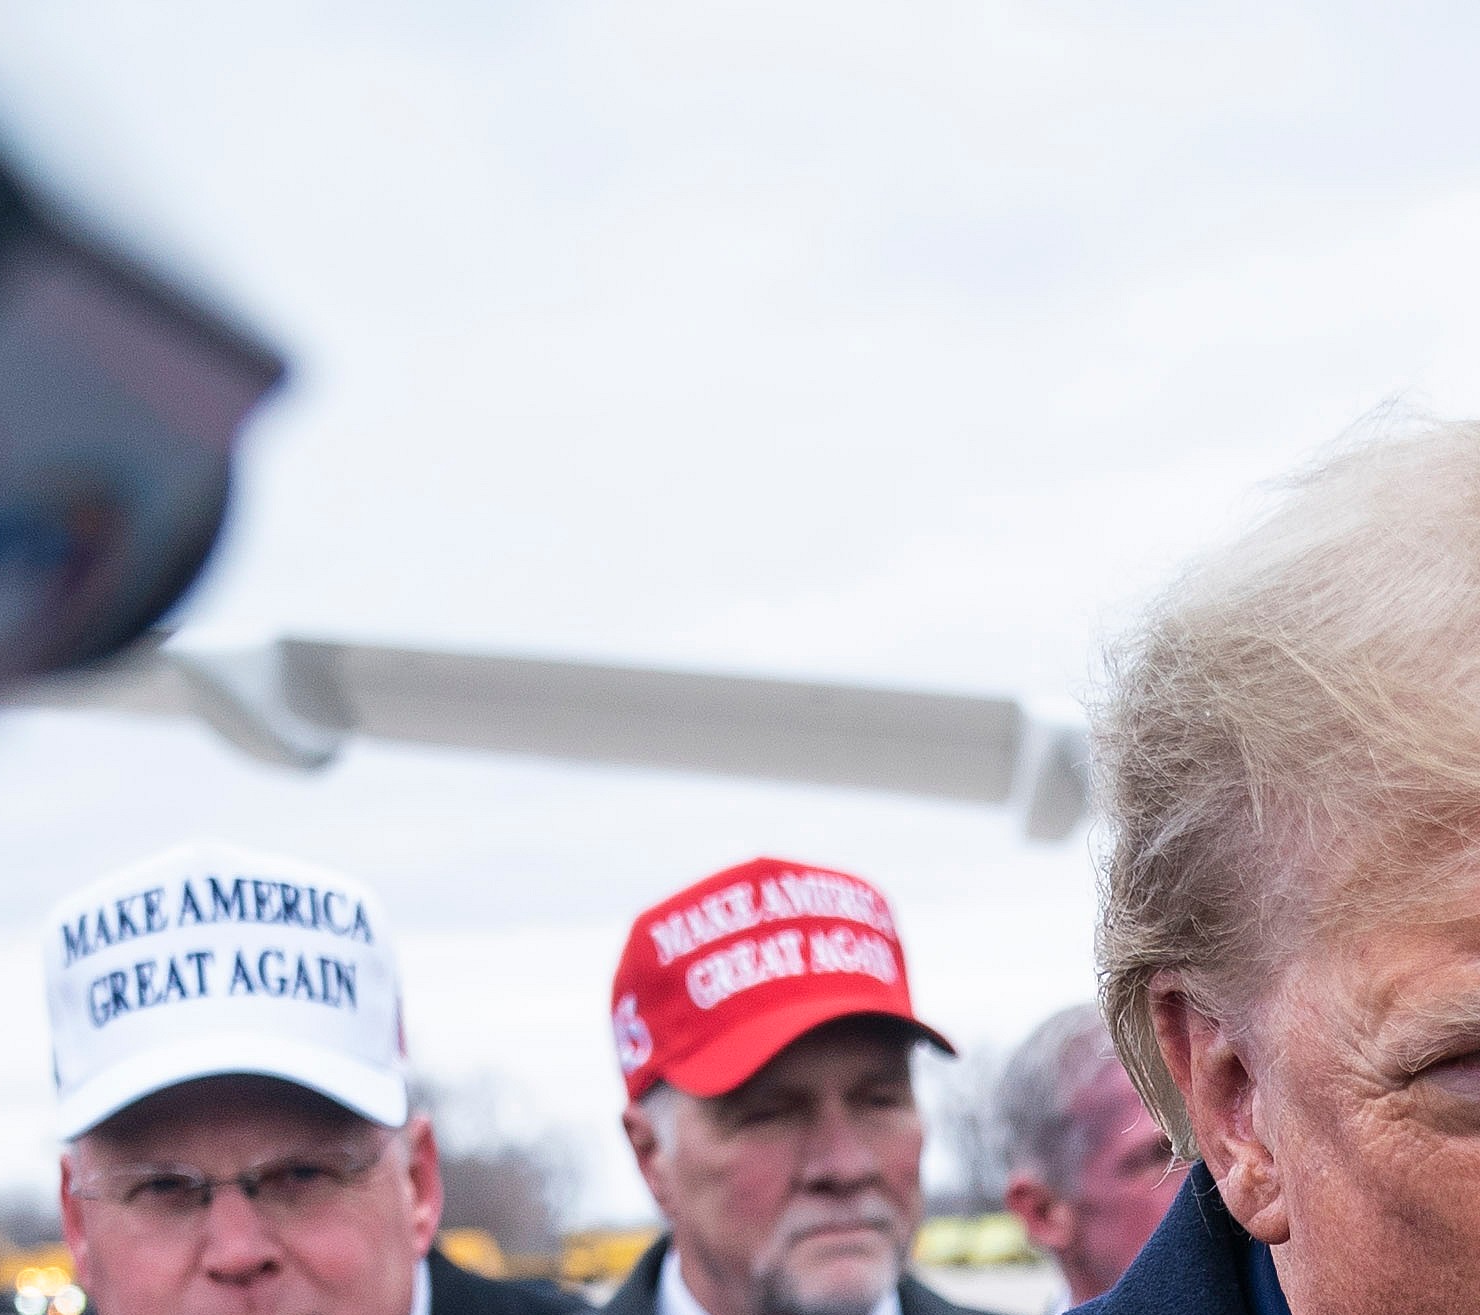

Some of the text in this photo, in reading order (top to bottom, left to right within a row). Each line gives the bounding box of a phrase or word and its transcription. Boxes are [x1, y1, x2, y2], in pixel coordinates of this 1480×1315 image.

[61, 875, 374, 968] MAKE AMERICA
[87, 948, 359, 1029] GREAT AGAIN
